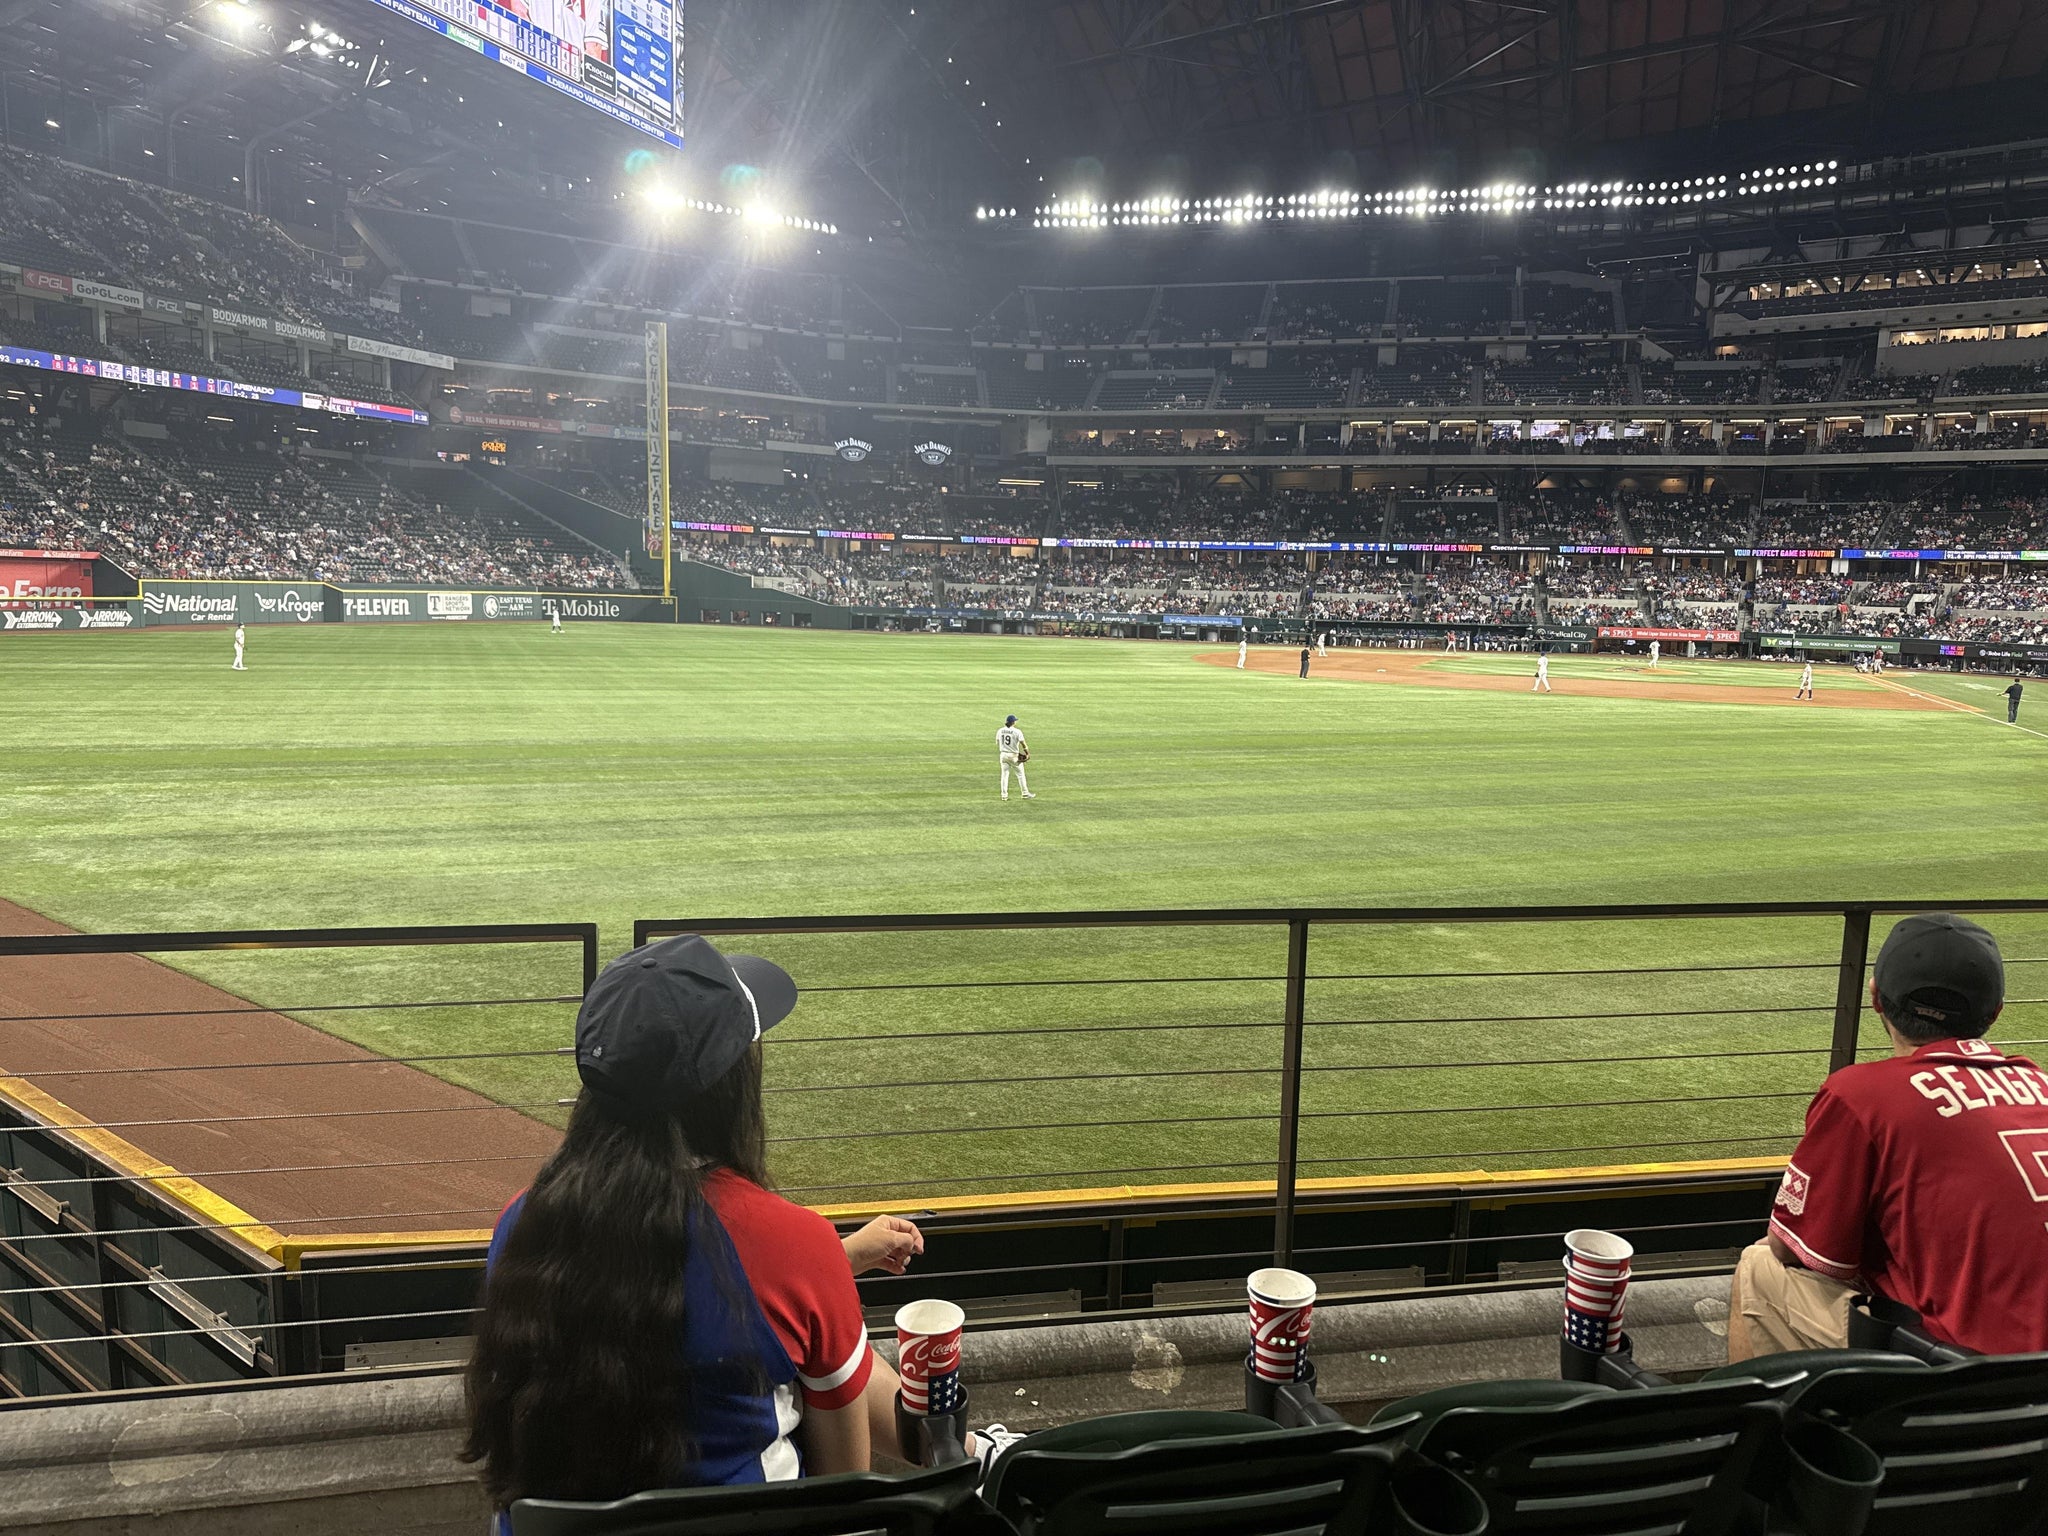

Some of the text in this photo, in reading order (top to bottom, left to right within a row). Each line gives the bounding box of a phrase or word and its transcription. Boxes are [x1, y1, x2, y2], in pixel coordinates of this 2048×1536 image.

[394, 0, 440, 29] FASTBALL
[501, 53, 516, 66] LAST
[546, 75, 584, 100] ILDEMARO
[585, 92, 613, 114] VARGAS
[612, 105, 631, 122] FLIED
[632, 115, 641, 126] TO
[641, 120, 665, 139] CENTER
[38, 275, 69, 291] PGL
[77, 284, 140, 305] GoPGL.com
[156, 300, 182, 314] PGL
[212, 309, 268, 332] BODYARMOR
[275, 322, 327, 342] BODYARMOR
[25, 358, 40, 368] 9.2
[233, 383, 275, 396] ARENADO
[465, 415, 484, 424] TEXAS,
[485, 417, 498, 425] THIS
[516, 419, 527, 427] FOR
[528, 420, 540, 428] YOU
[834, 437, 873, 452] JACK DANIEL'S
[914, 441, 952, 455] JACK DANIEL'S
[651, 474, 661, 528] FARE
[1576, 546, 1601, 554] PERFECT
[1628, 547, 1653, 555] WAITING
[1734, 549, 1751, 557] YOUR
[1752, 549, 1779, 557] PERFECT
[1807, 550, 1835, 558] WAITING
[278, 591, 324, 622] Kroger
[561, 599, 620, 617] Mobile
[19, 611, 54, 622] ARROW
[93, 611, 127, 622] ARROW
[191, 612, 234, 621] Car Rental
[1574, 631, 1587, 640] City
[1001, 735, 1011, 746] 19
